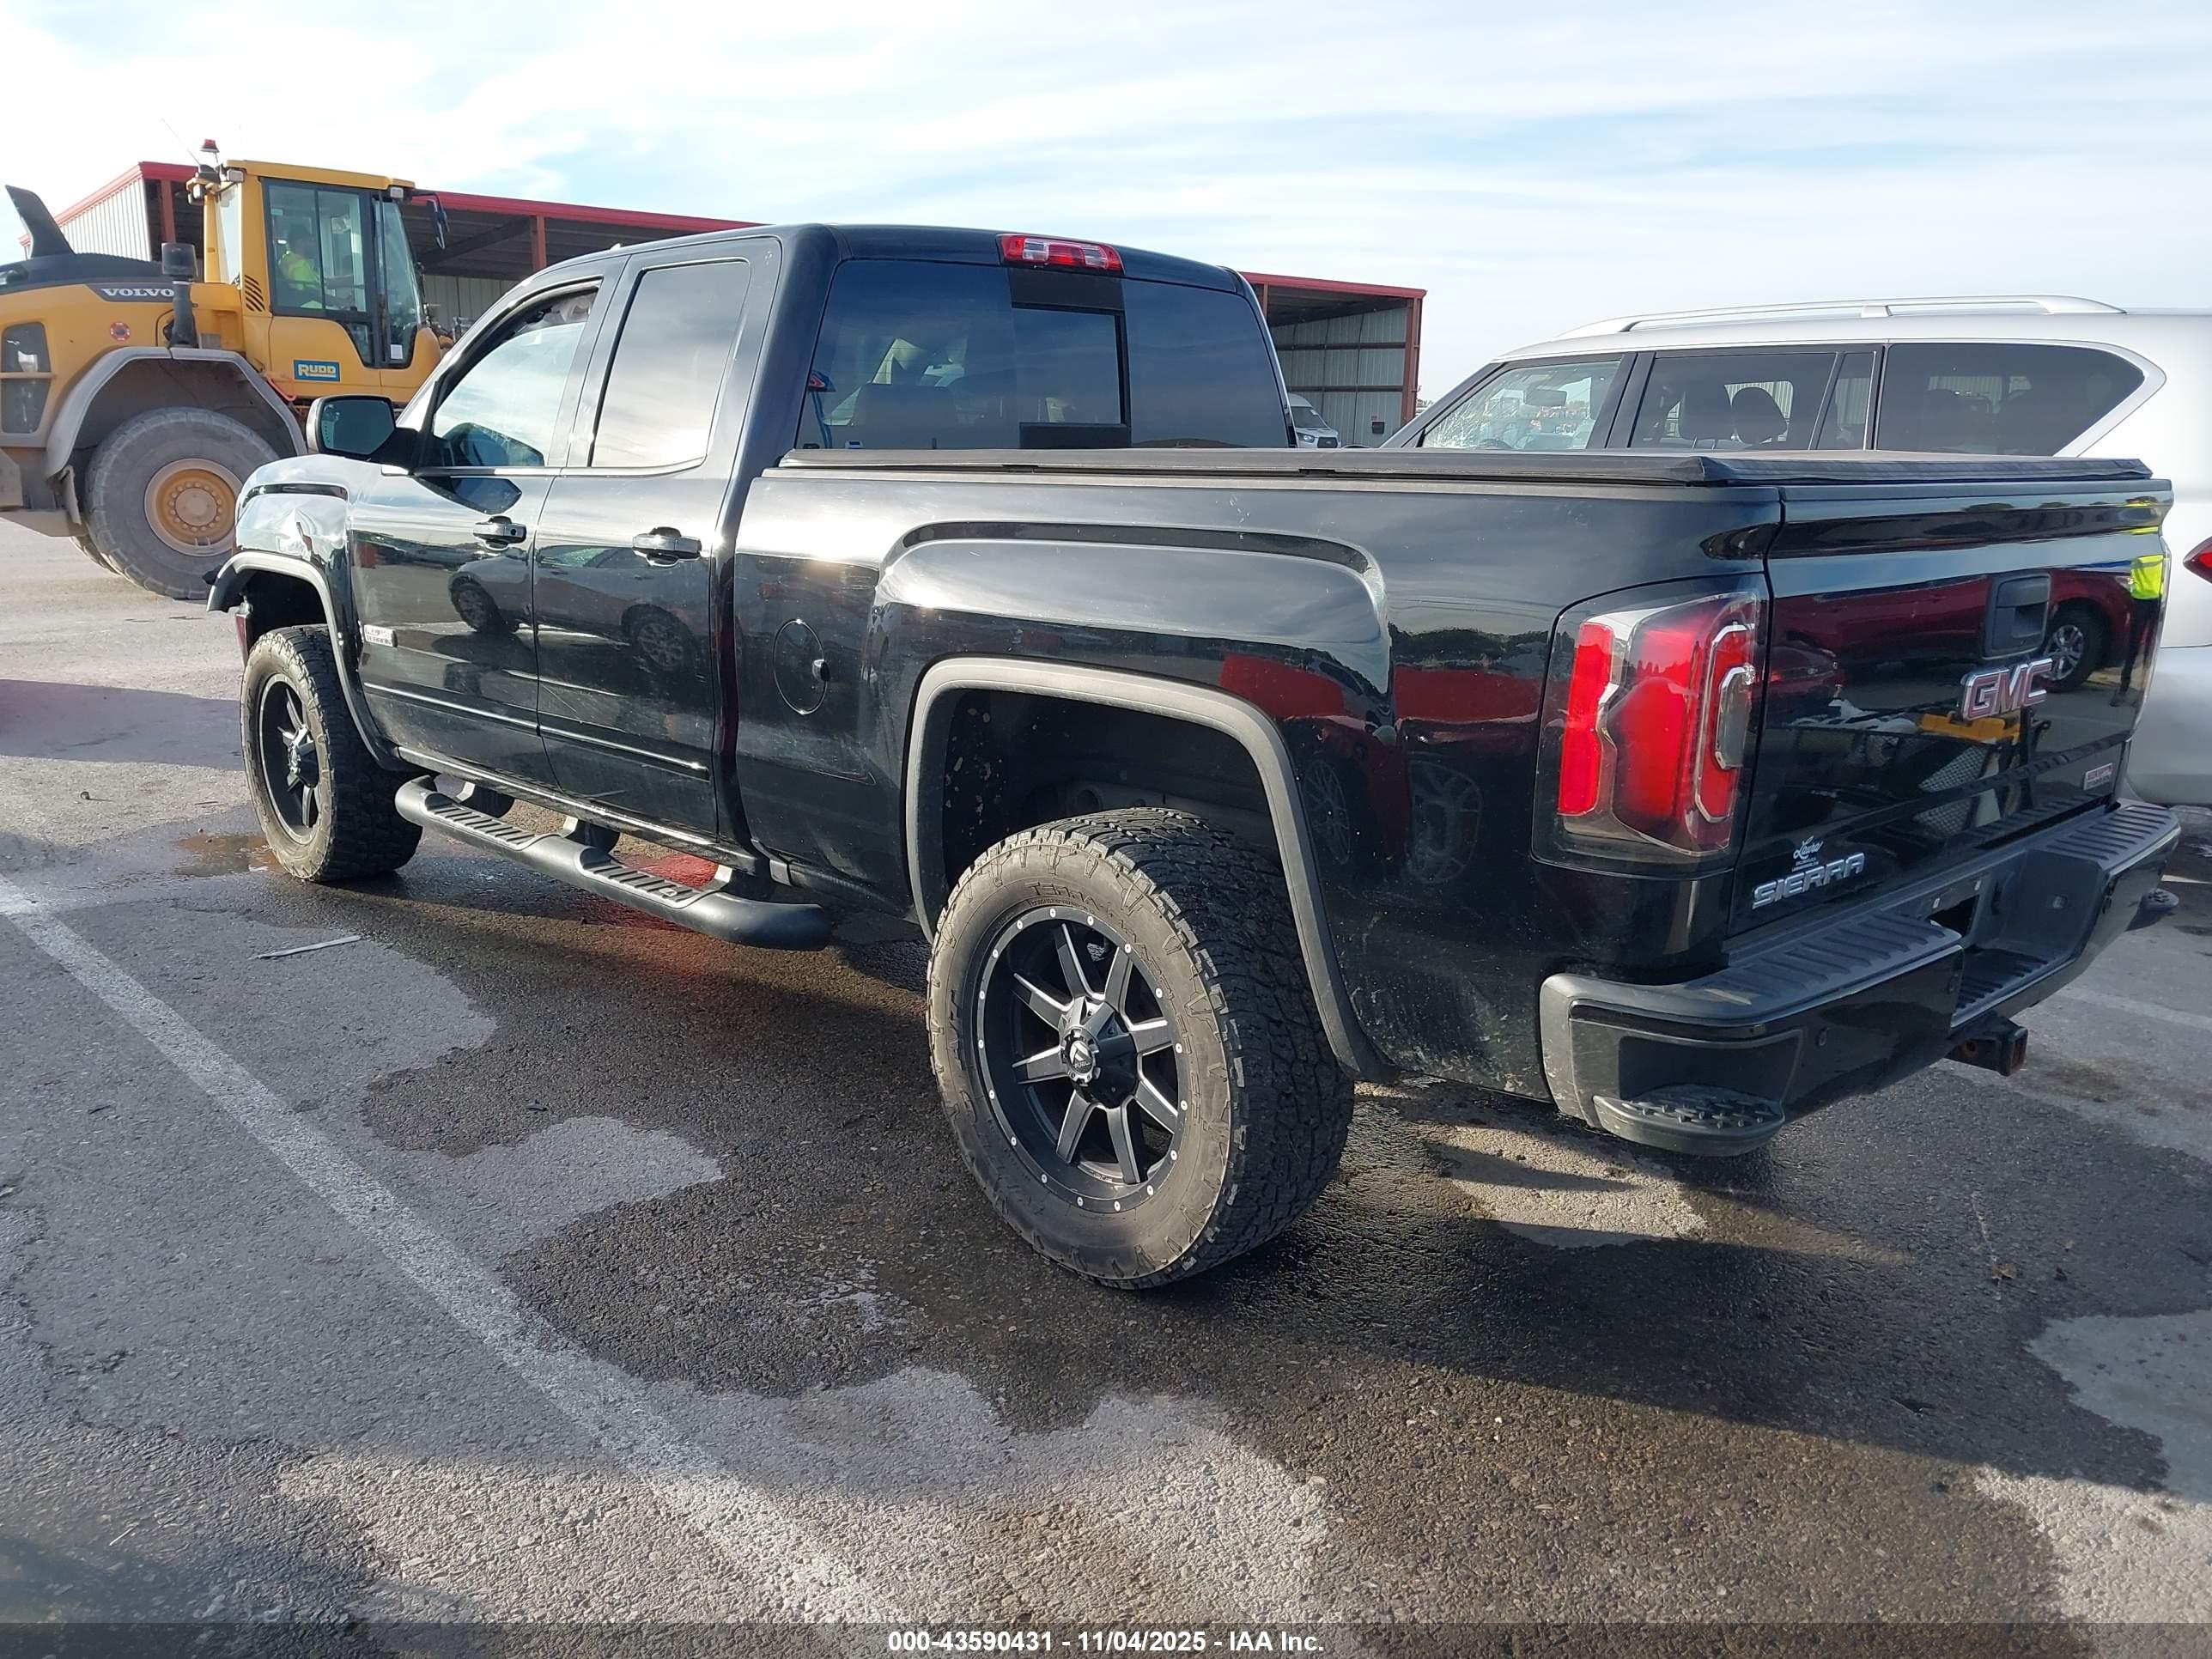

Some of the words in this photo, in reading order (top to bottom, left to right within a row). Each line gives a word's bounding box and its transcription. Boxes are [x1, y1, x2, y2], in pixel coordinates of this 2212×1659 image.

[100, 288, 175, 297] VOLVO
[297, 363, 337, 378] RUDD
[1962, 658, 2053, 721] GMC
[1752, 852, 1865, 910] SIERRA
